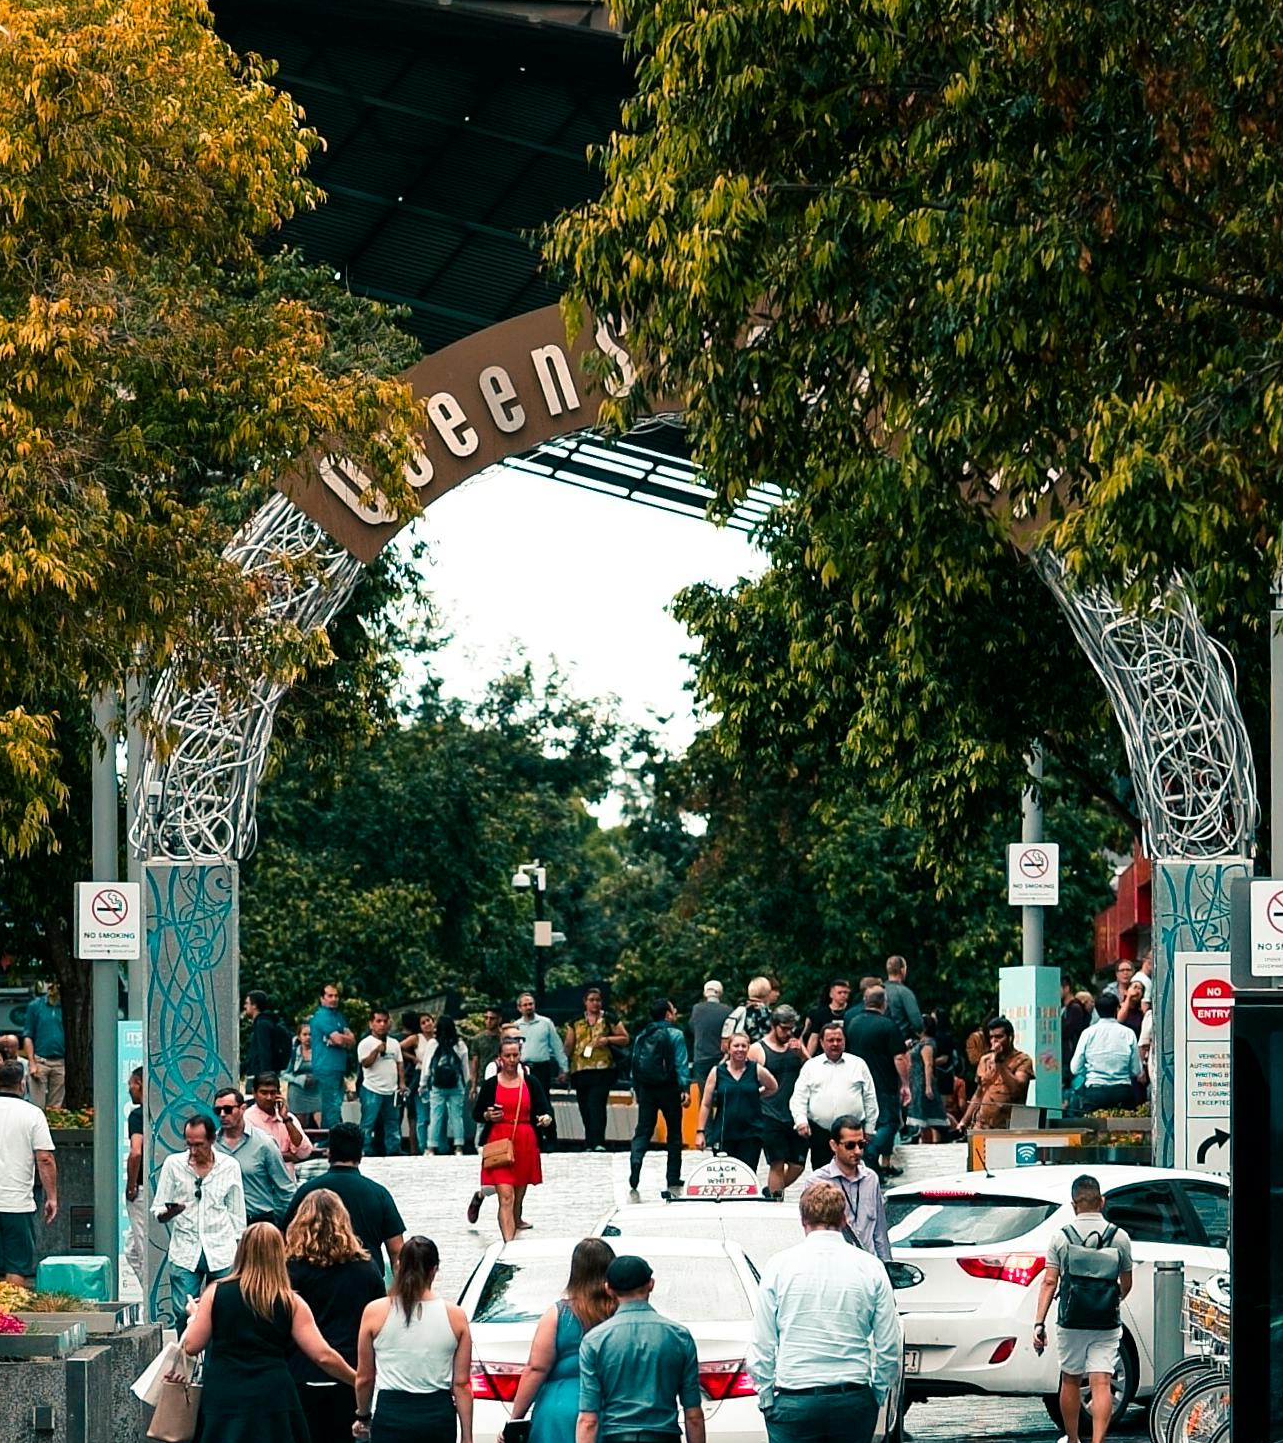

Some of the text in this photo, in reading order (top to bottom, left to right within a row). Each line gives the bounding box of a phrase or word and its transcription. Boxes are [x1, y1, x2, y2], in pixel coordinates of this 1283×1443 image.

[1207, 987, 1222, 996] NO
[1198, 1010, 1230, 1019] ENTRY
[697, 1186, 749, 1195] 133 222
